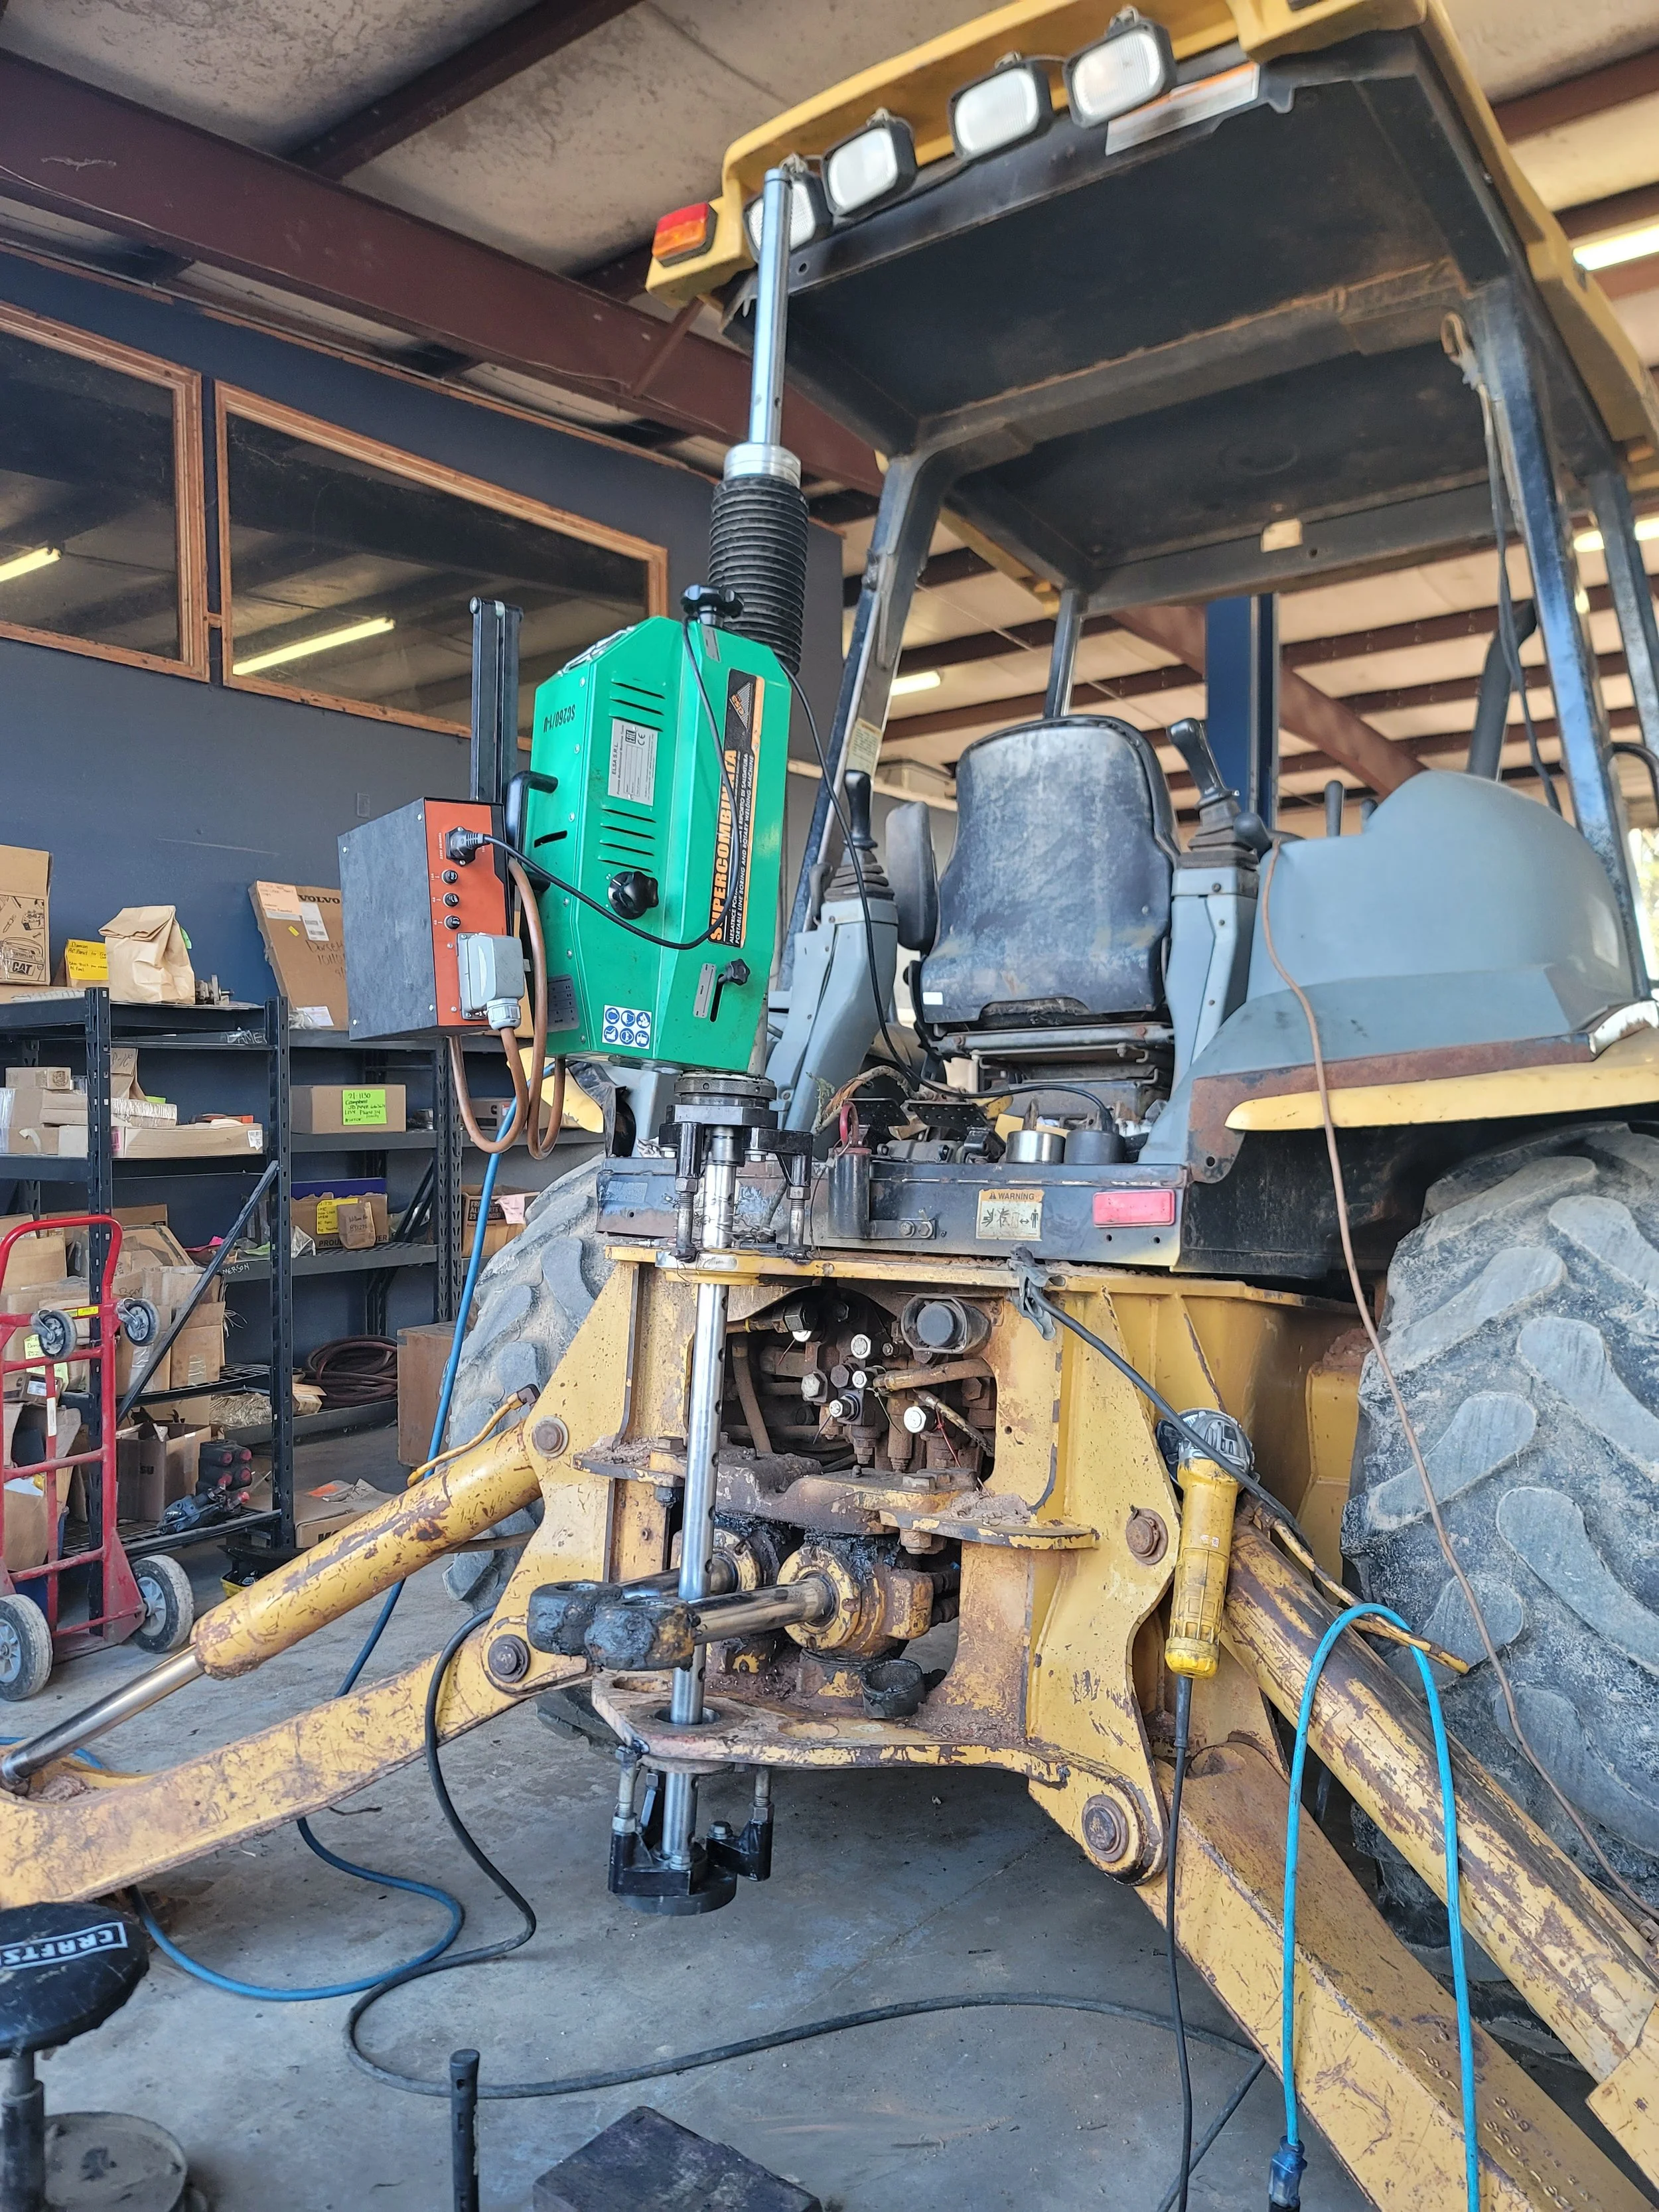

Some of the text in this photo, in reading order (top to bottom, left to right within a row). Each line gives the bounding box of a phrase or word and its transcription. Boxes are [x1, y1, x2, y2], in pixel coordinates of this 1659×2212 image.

[299, 895, 340, 904] VOLVO
[13, 962, 33, 975] CAT
[0, 1929, 114, 1966] CRAFTS
